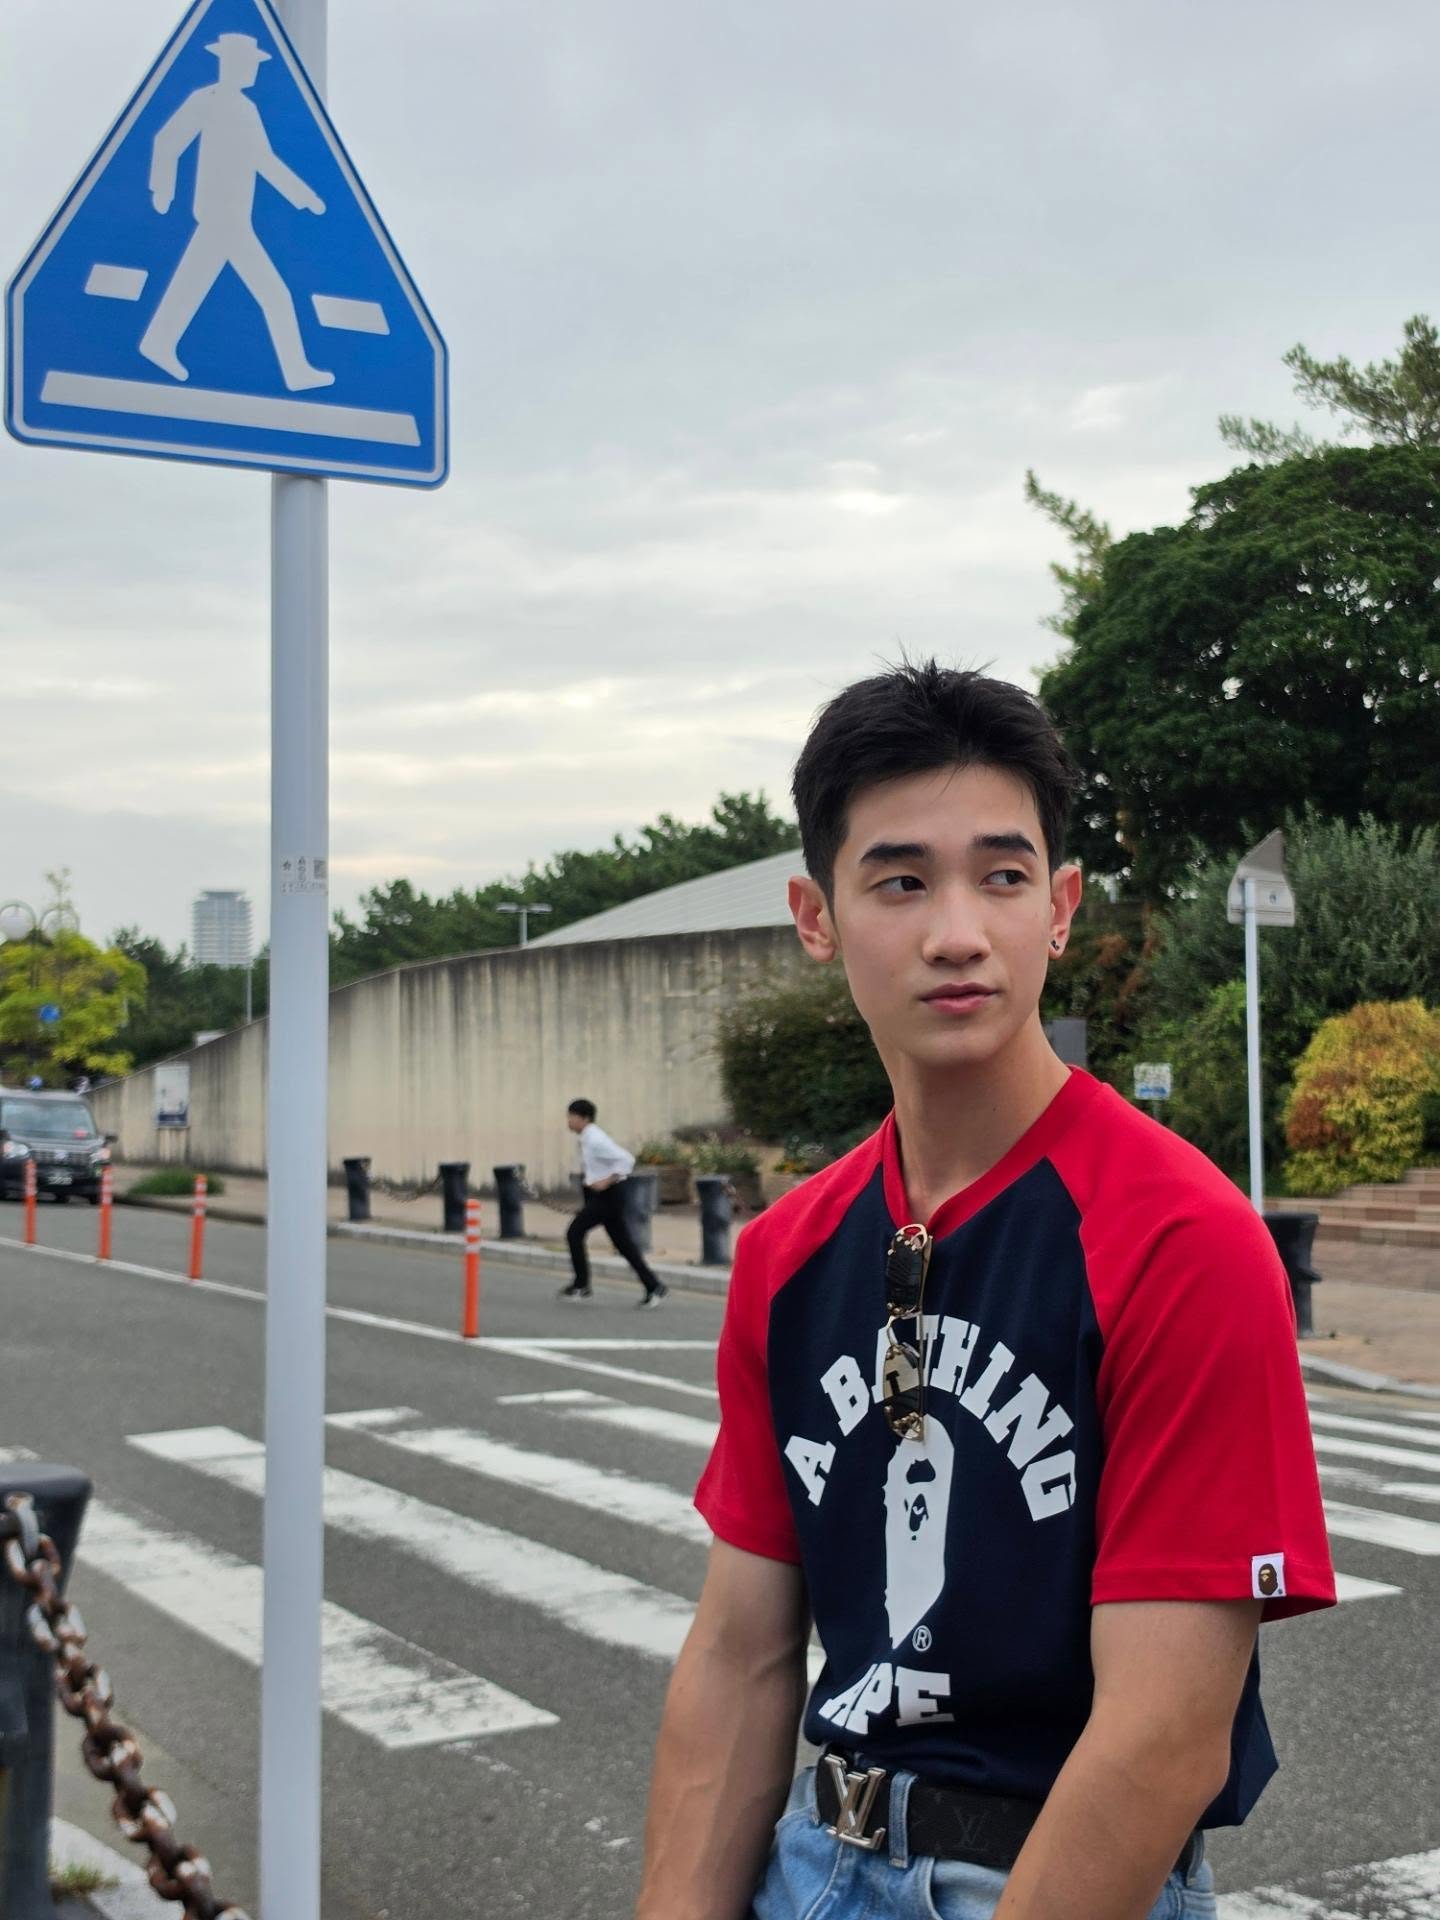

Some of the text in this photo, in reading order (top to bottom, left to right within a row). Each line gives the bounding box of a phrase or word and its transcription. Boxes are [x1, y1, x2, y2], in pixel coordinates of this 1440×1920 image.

[784, 1313, 1078, 1523] A BATHING
[818, 1662, 955, 1735] APE
